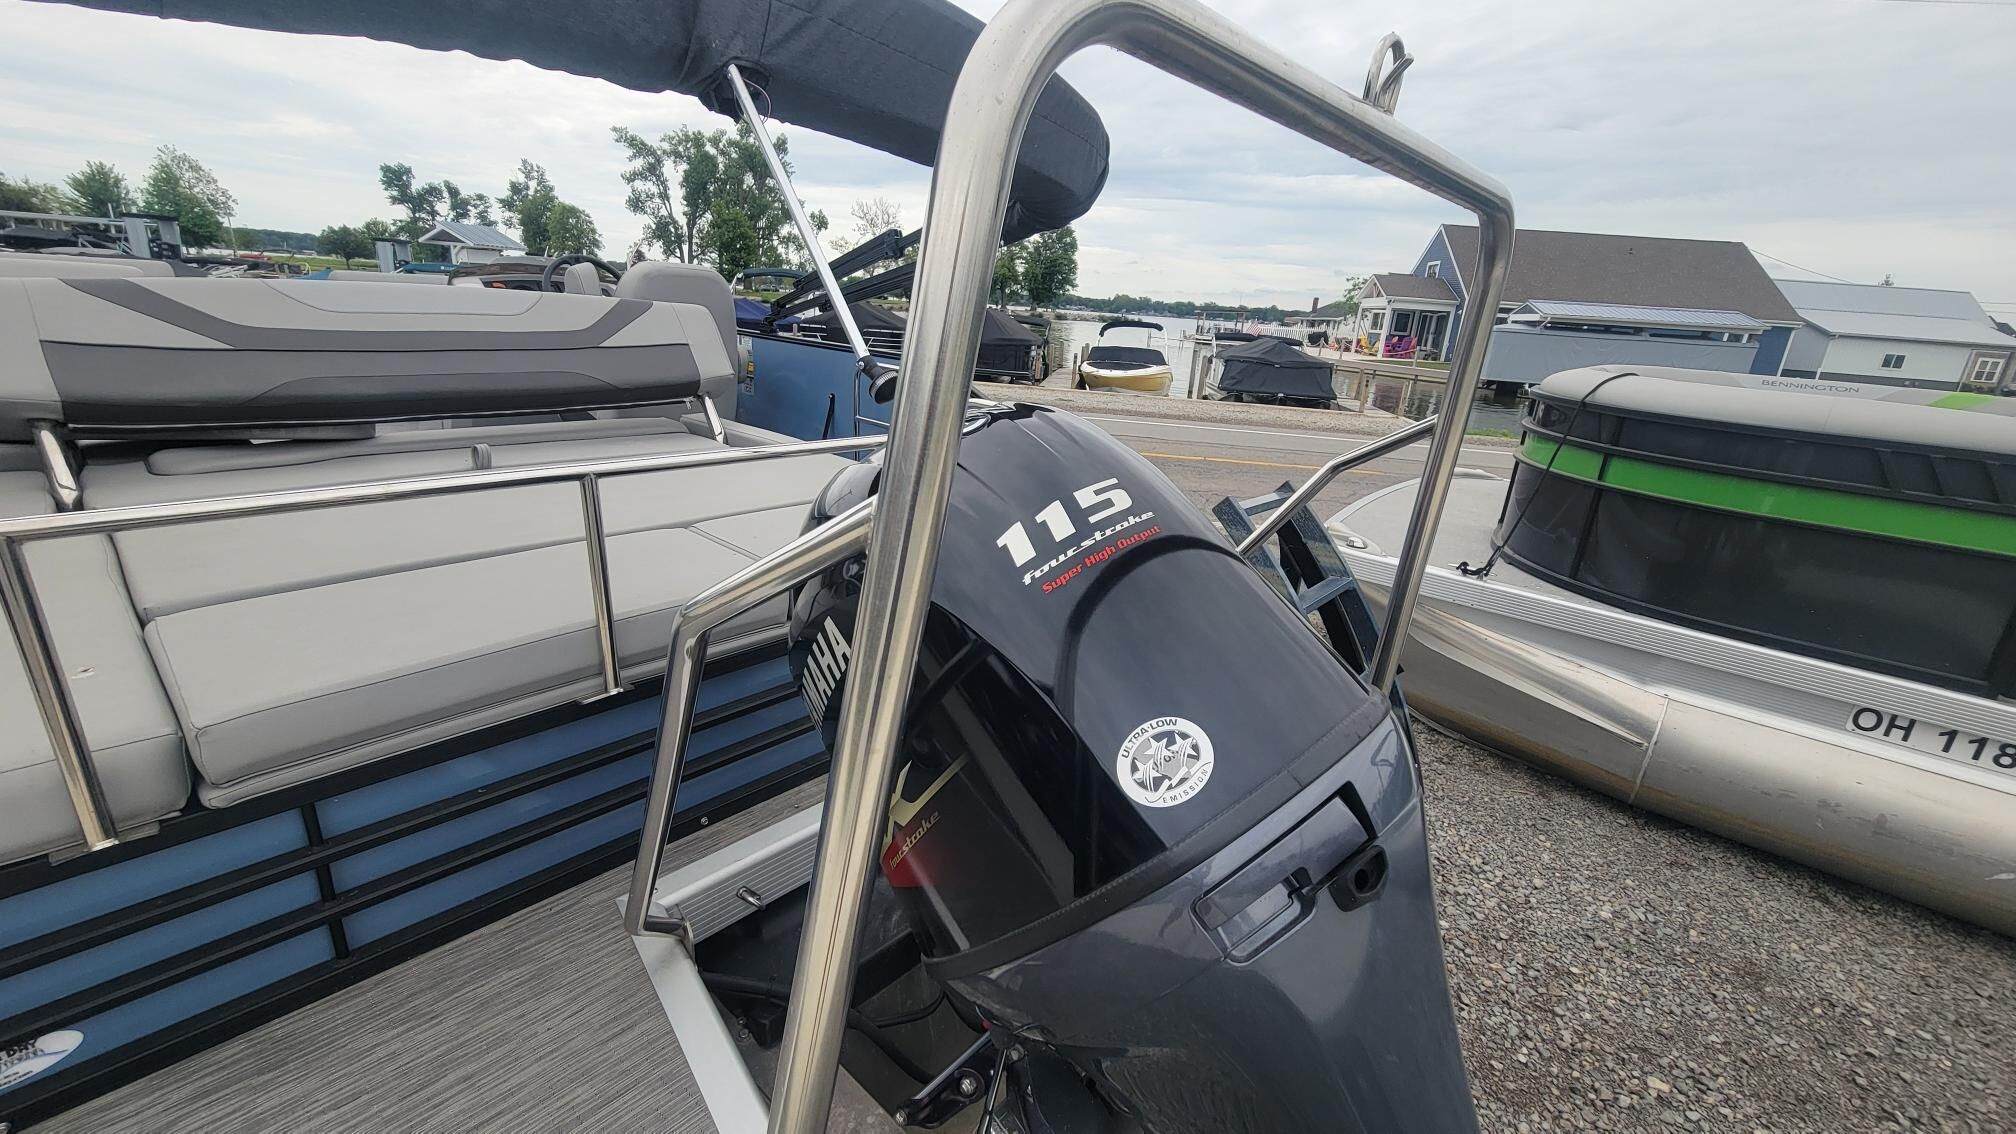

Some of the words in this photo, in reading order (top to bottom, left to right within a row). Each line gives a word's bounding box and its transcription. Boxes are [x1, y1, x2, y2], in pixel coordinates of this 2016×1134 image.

[1761, 379, 1860, 393] BENNINGTON
[996, 477, 1133, 567] 115
[1022, 511, 1155, 585] fourstroke
[1041, 564, 1083, 594] Super
[1084, 544, 1117, 568] High
[1117, 525, 1161, 550] Output
[1852, 707, 1917, 742] OH
[1938, 729, 2016, 769] 118
[1162, 768, 1209, 804] EMISSION
